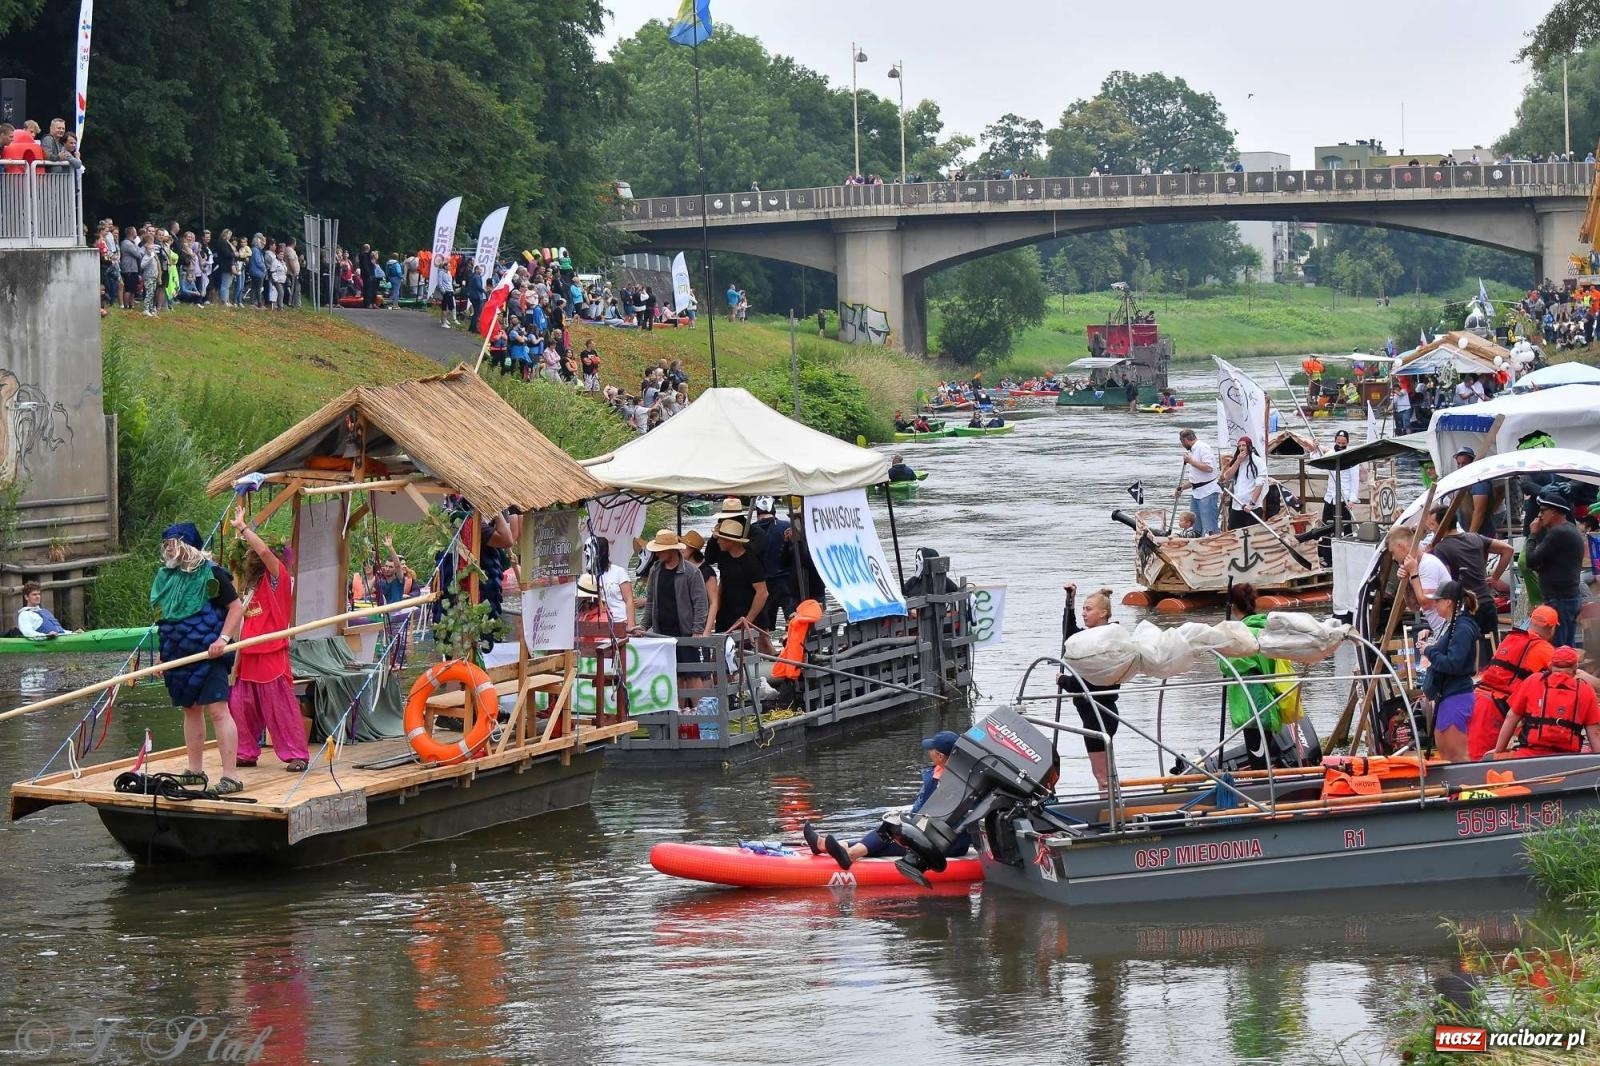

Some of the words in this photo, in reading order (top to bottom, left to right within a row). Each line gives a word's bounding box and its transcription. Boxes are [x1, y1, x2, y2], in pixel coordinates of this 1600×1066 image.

[812, 505, 864, 534] FINANSOWE
[995, 725, 1042, 763] Johnson
[1135, 848, 1170, 869] OSP
[1175, 838, 1263, 865] MIEDONIA
[1343, 828, 1366, 849] R1
